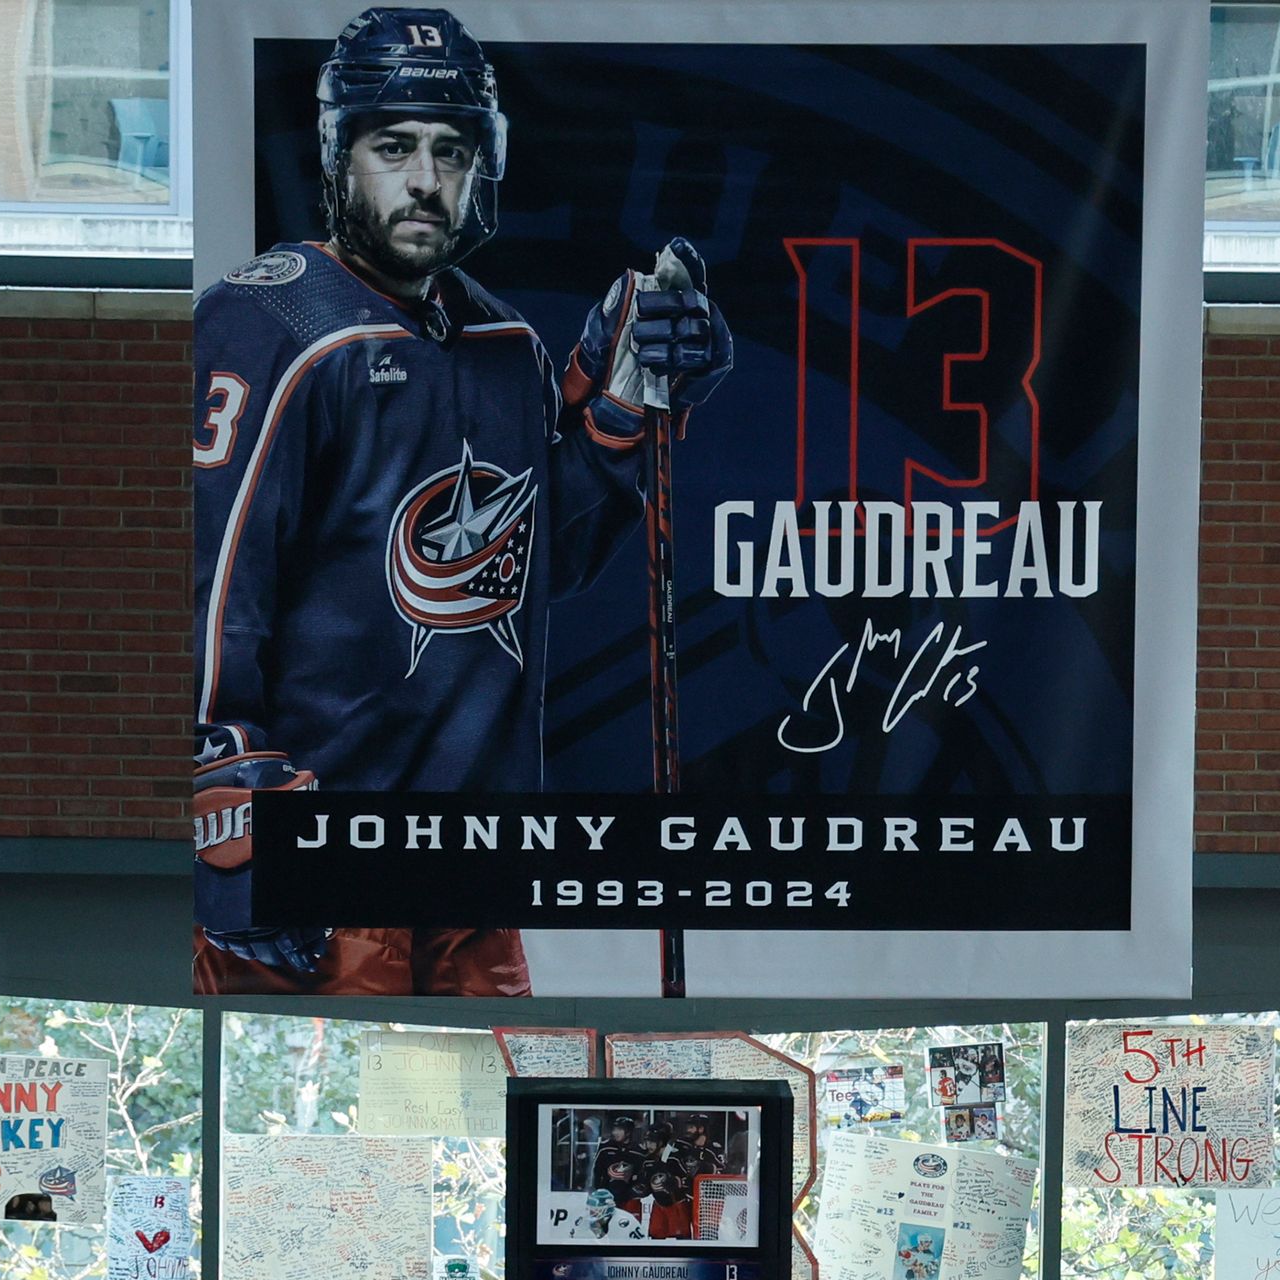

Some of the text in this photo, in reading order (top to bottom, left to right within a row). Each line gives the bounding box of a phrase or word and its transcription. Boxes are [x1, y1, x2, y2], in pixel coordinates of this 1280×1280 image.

[407, 25, 443, 47] 13
[369, 369, 408, 383] Safelite
[785, 238, 1043, 536] 13
[714, 501, 1103, 598] GAUDREAU
[297, 815, 1087, 852] JOHNNY GAUDREAU
[532, 880, 853, 908] 1993-2024
[24, 1058, 87, 1078] PEACE
[392, 1052, 474, 1073] JOHNNY
[480, 1055, 497, 1073] 13
[1122, 1030, 1206, 1083] 5TH
[1113, 1085, 1207, 1133] LINE
[1094, 1132, 1254, 1185] STRONG
[607, 1266, 641, 1279] JOHNNY
[642, 1266, 688, 1279] GAUDREAU
